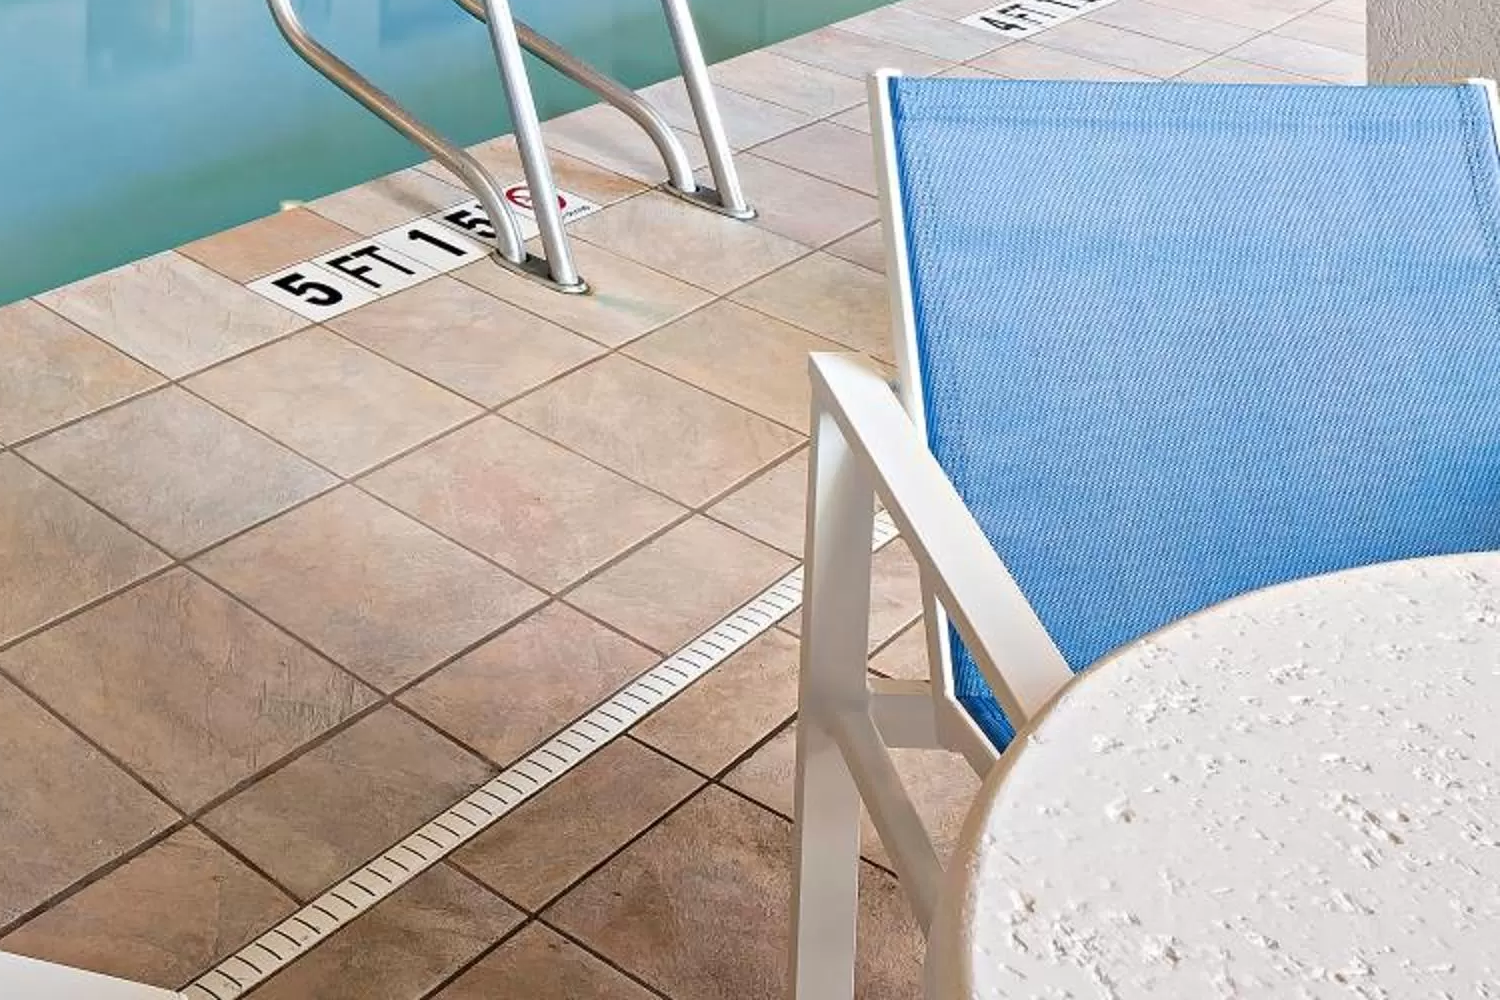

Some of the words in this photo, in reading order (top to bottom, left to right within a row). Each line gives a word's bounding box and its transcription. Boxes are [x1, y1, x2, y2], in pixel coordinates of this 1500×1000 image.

[979, 16, 1027, 31] 4
[997, 3, 1056, 25] FT
[271, 272, 344, 307] 5
[326, 245, 416, 289] FT
